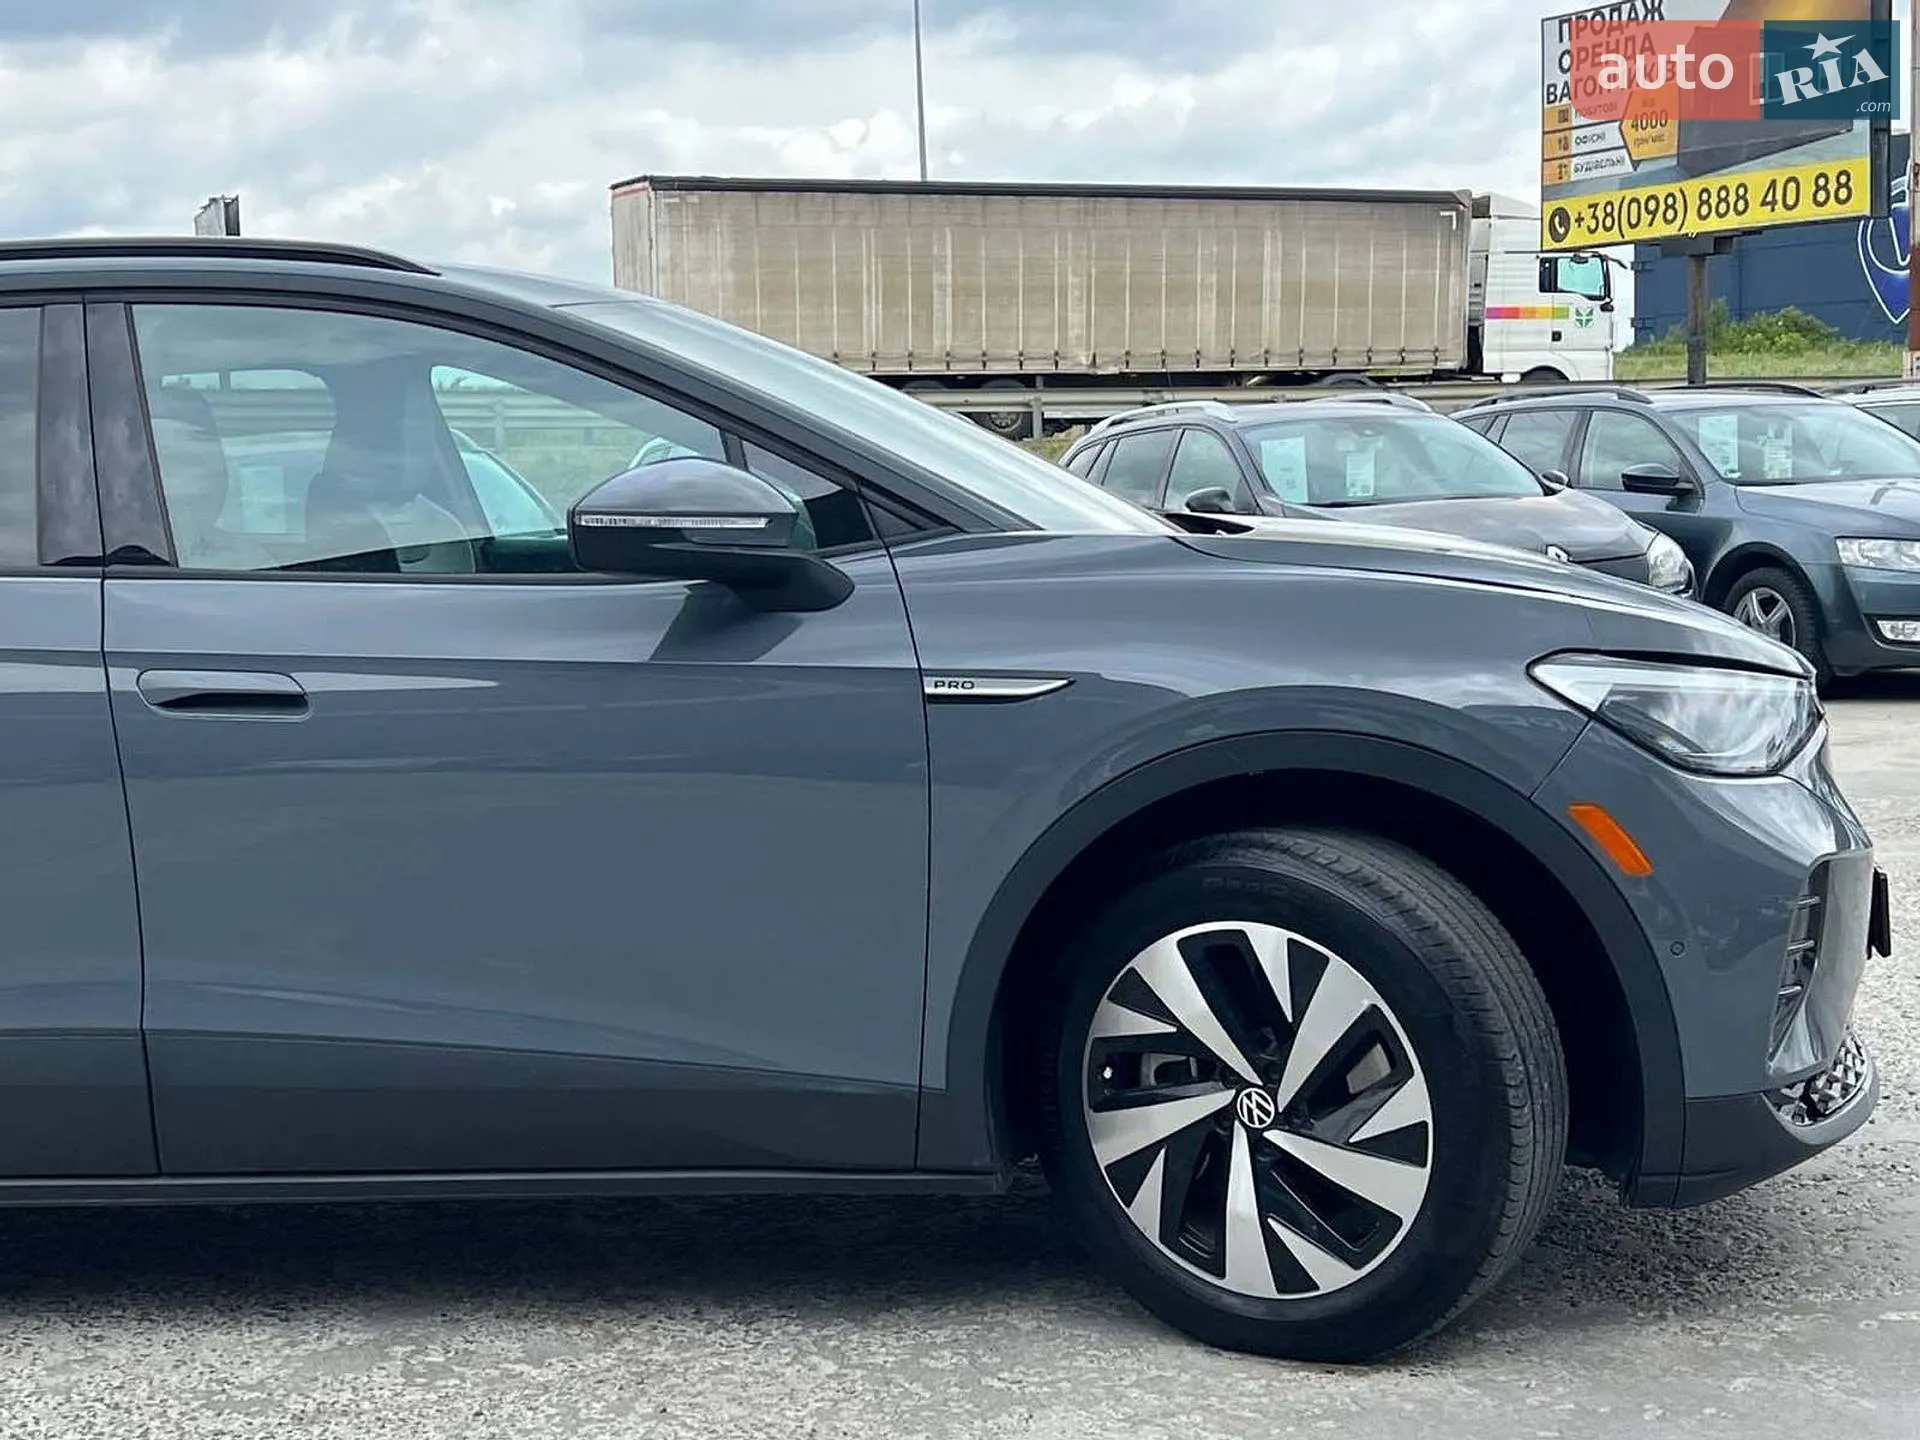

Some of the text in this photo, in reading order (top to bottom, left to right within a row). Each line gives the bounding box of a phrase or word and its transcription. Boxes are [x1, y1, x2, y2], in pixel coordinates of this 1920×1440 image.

[1558, 0, 1665, 43] ПРОДАЖ
[1558, 31, 1656, 75] ОРЕНДА
[1545, 60, 1677, 105] ВАГОИКВ
[1631, 108, 1669, 132] 4000
[1574, 169, 1853, 239] +38(098) 888 40 88
[934, 680, 975, 690] PRO
